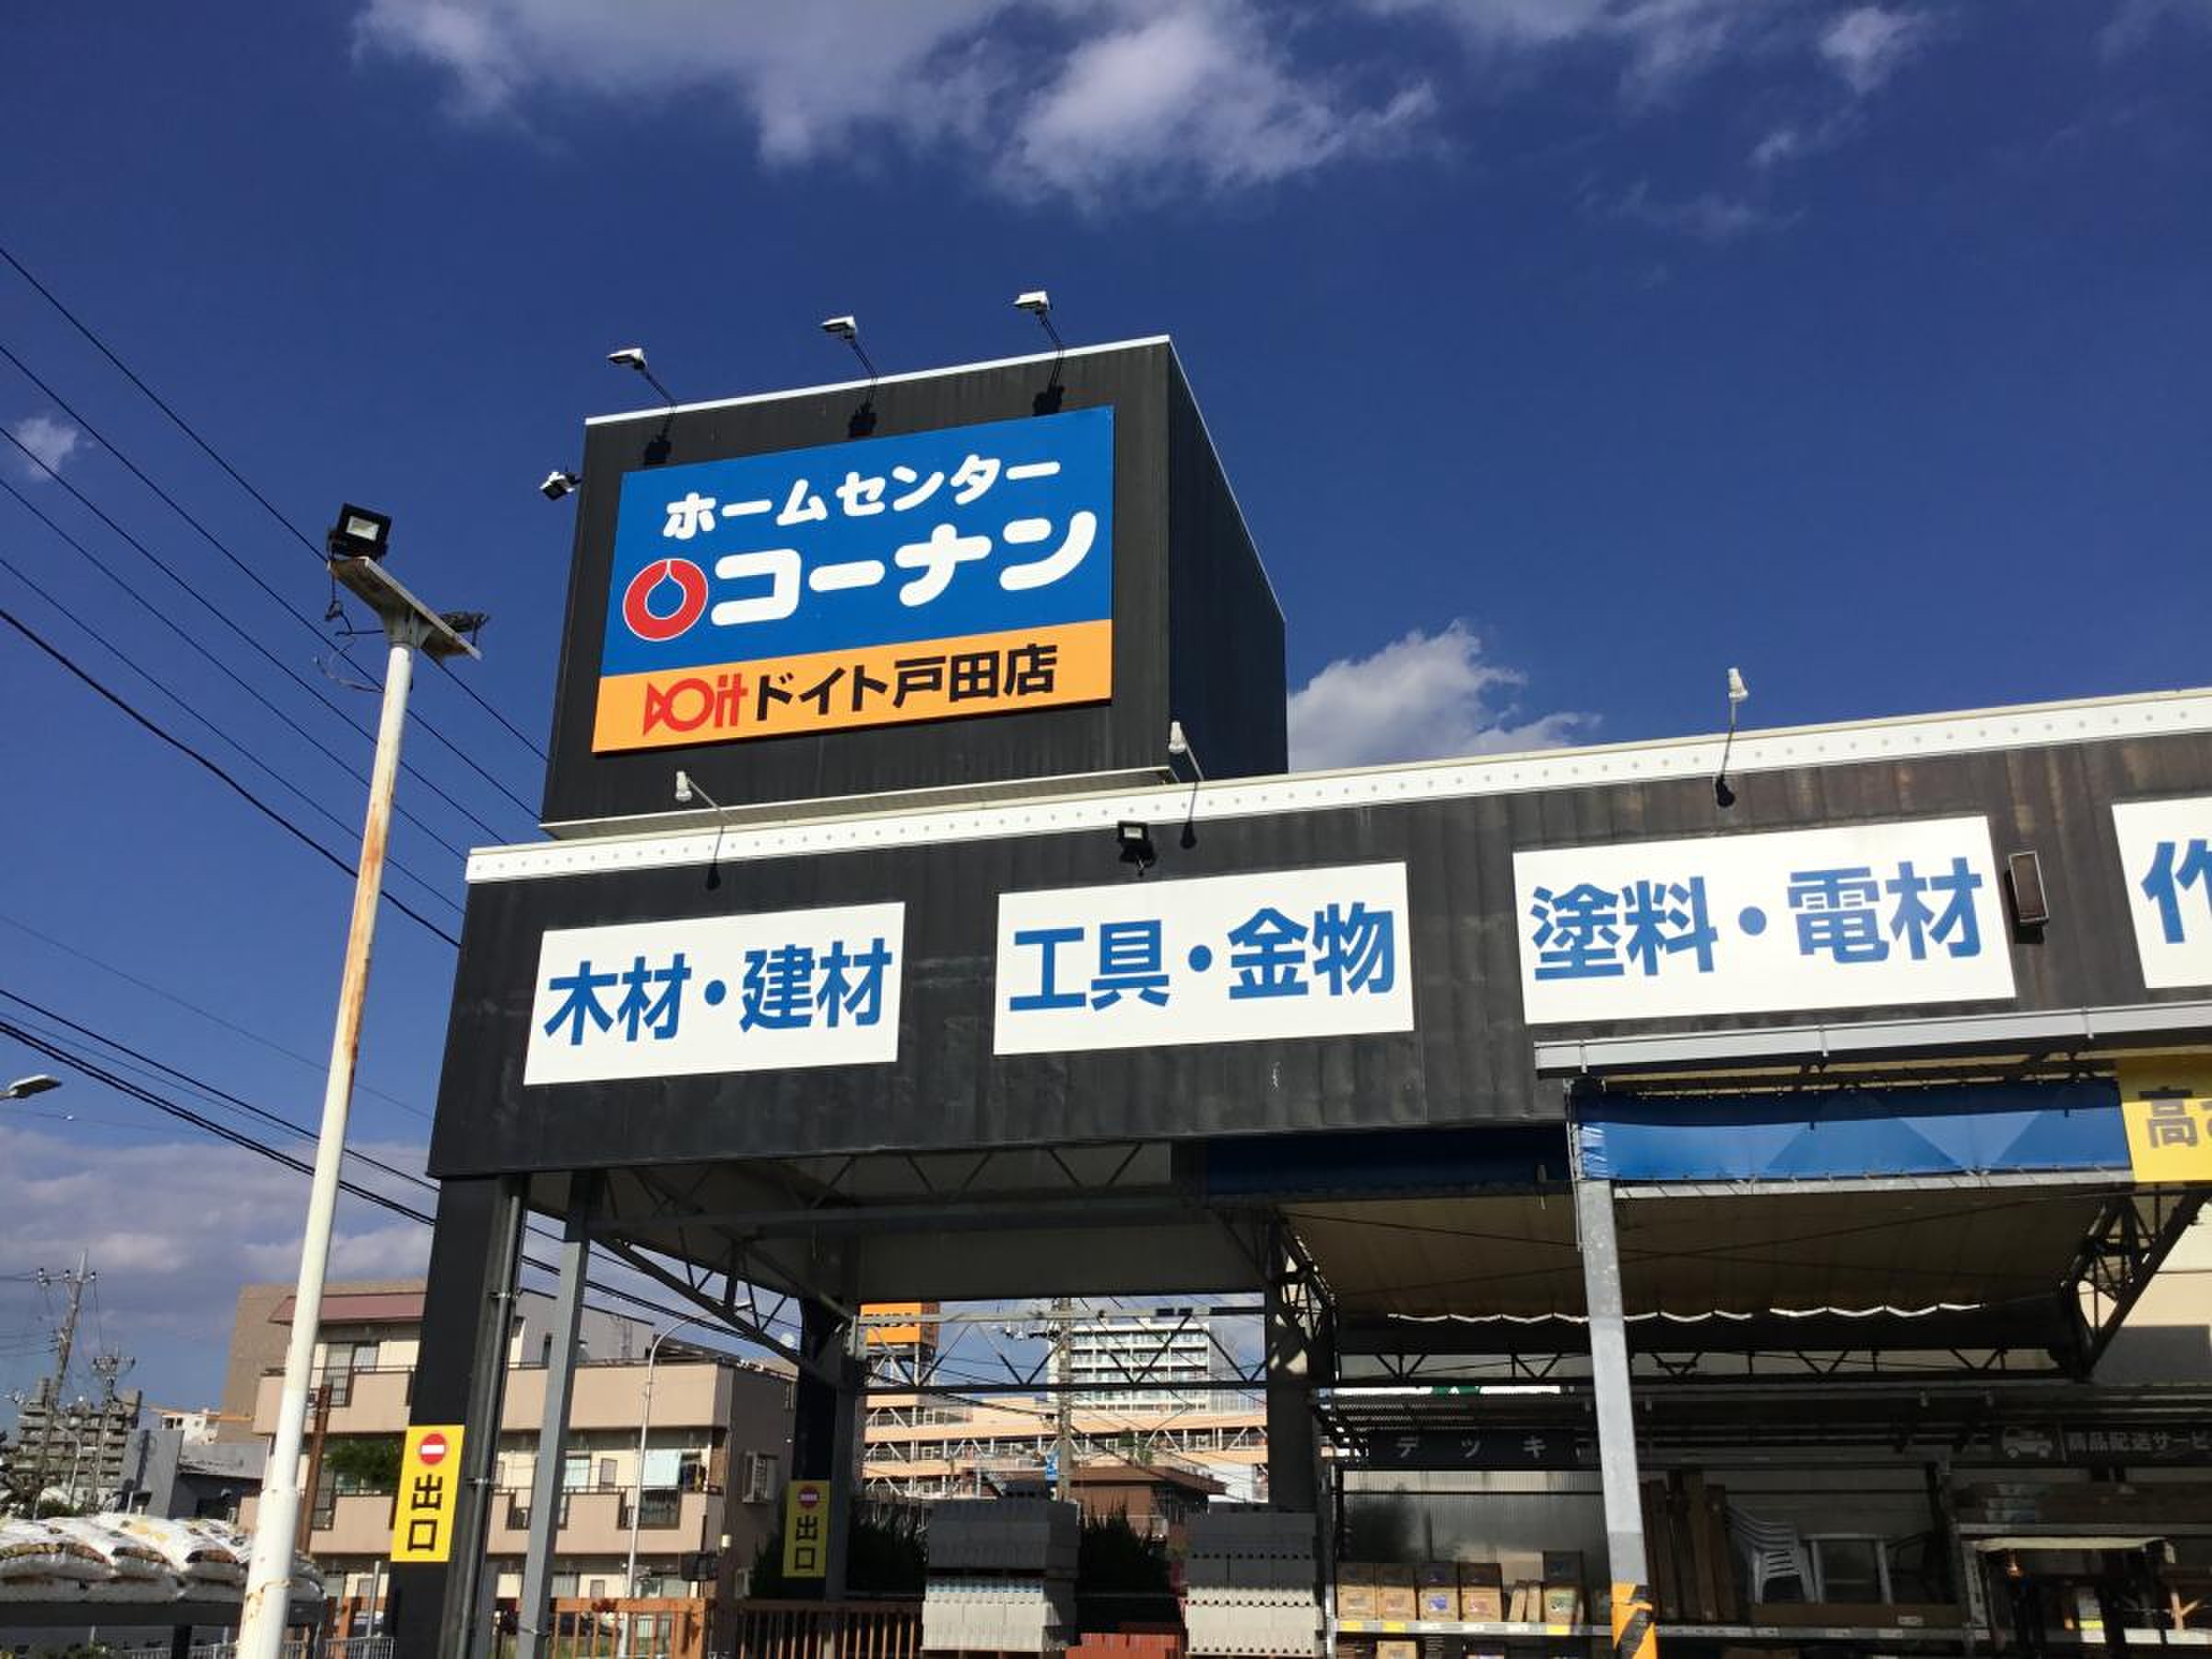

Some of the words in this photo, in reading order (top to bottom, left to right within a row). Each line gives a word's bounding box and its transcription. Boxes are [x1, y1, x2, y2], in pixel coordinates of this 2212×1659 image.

[663, 454, 1061, 538] ホームセンター
[711, 512, 1097, 627] コーナン
[757, 644, 1057, 722] ドイト戸田店
[1009, 901, 1395, 1011] 工具・金物
[1531, 857, 1983, 981] 塗料・電材
[543, 937, 892, 1045] 木材・建材
[407, 1474, 443, 1551] 出口
[794, 1514, 818, 1572] 出口
